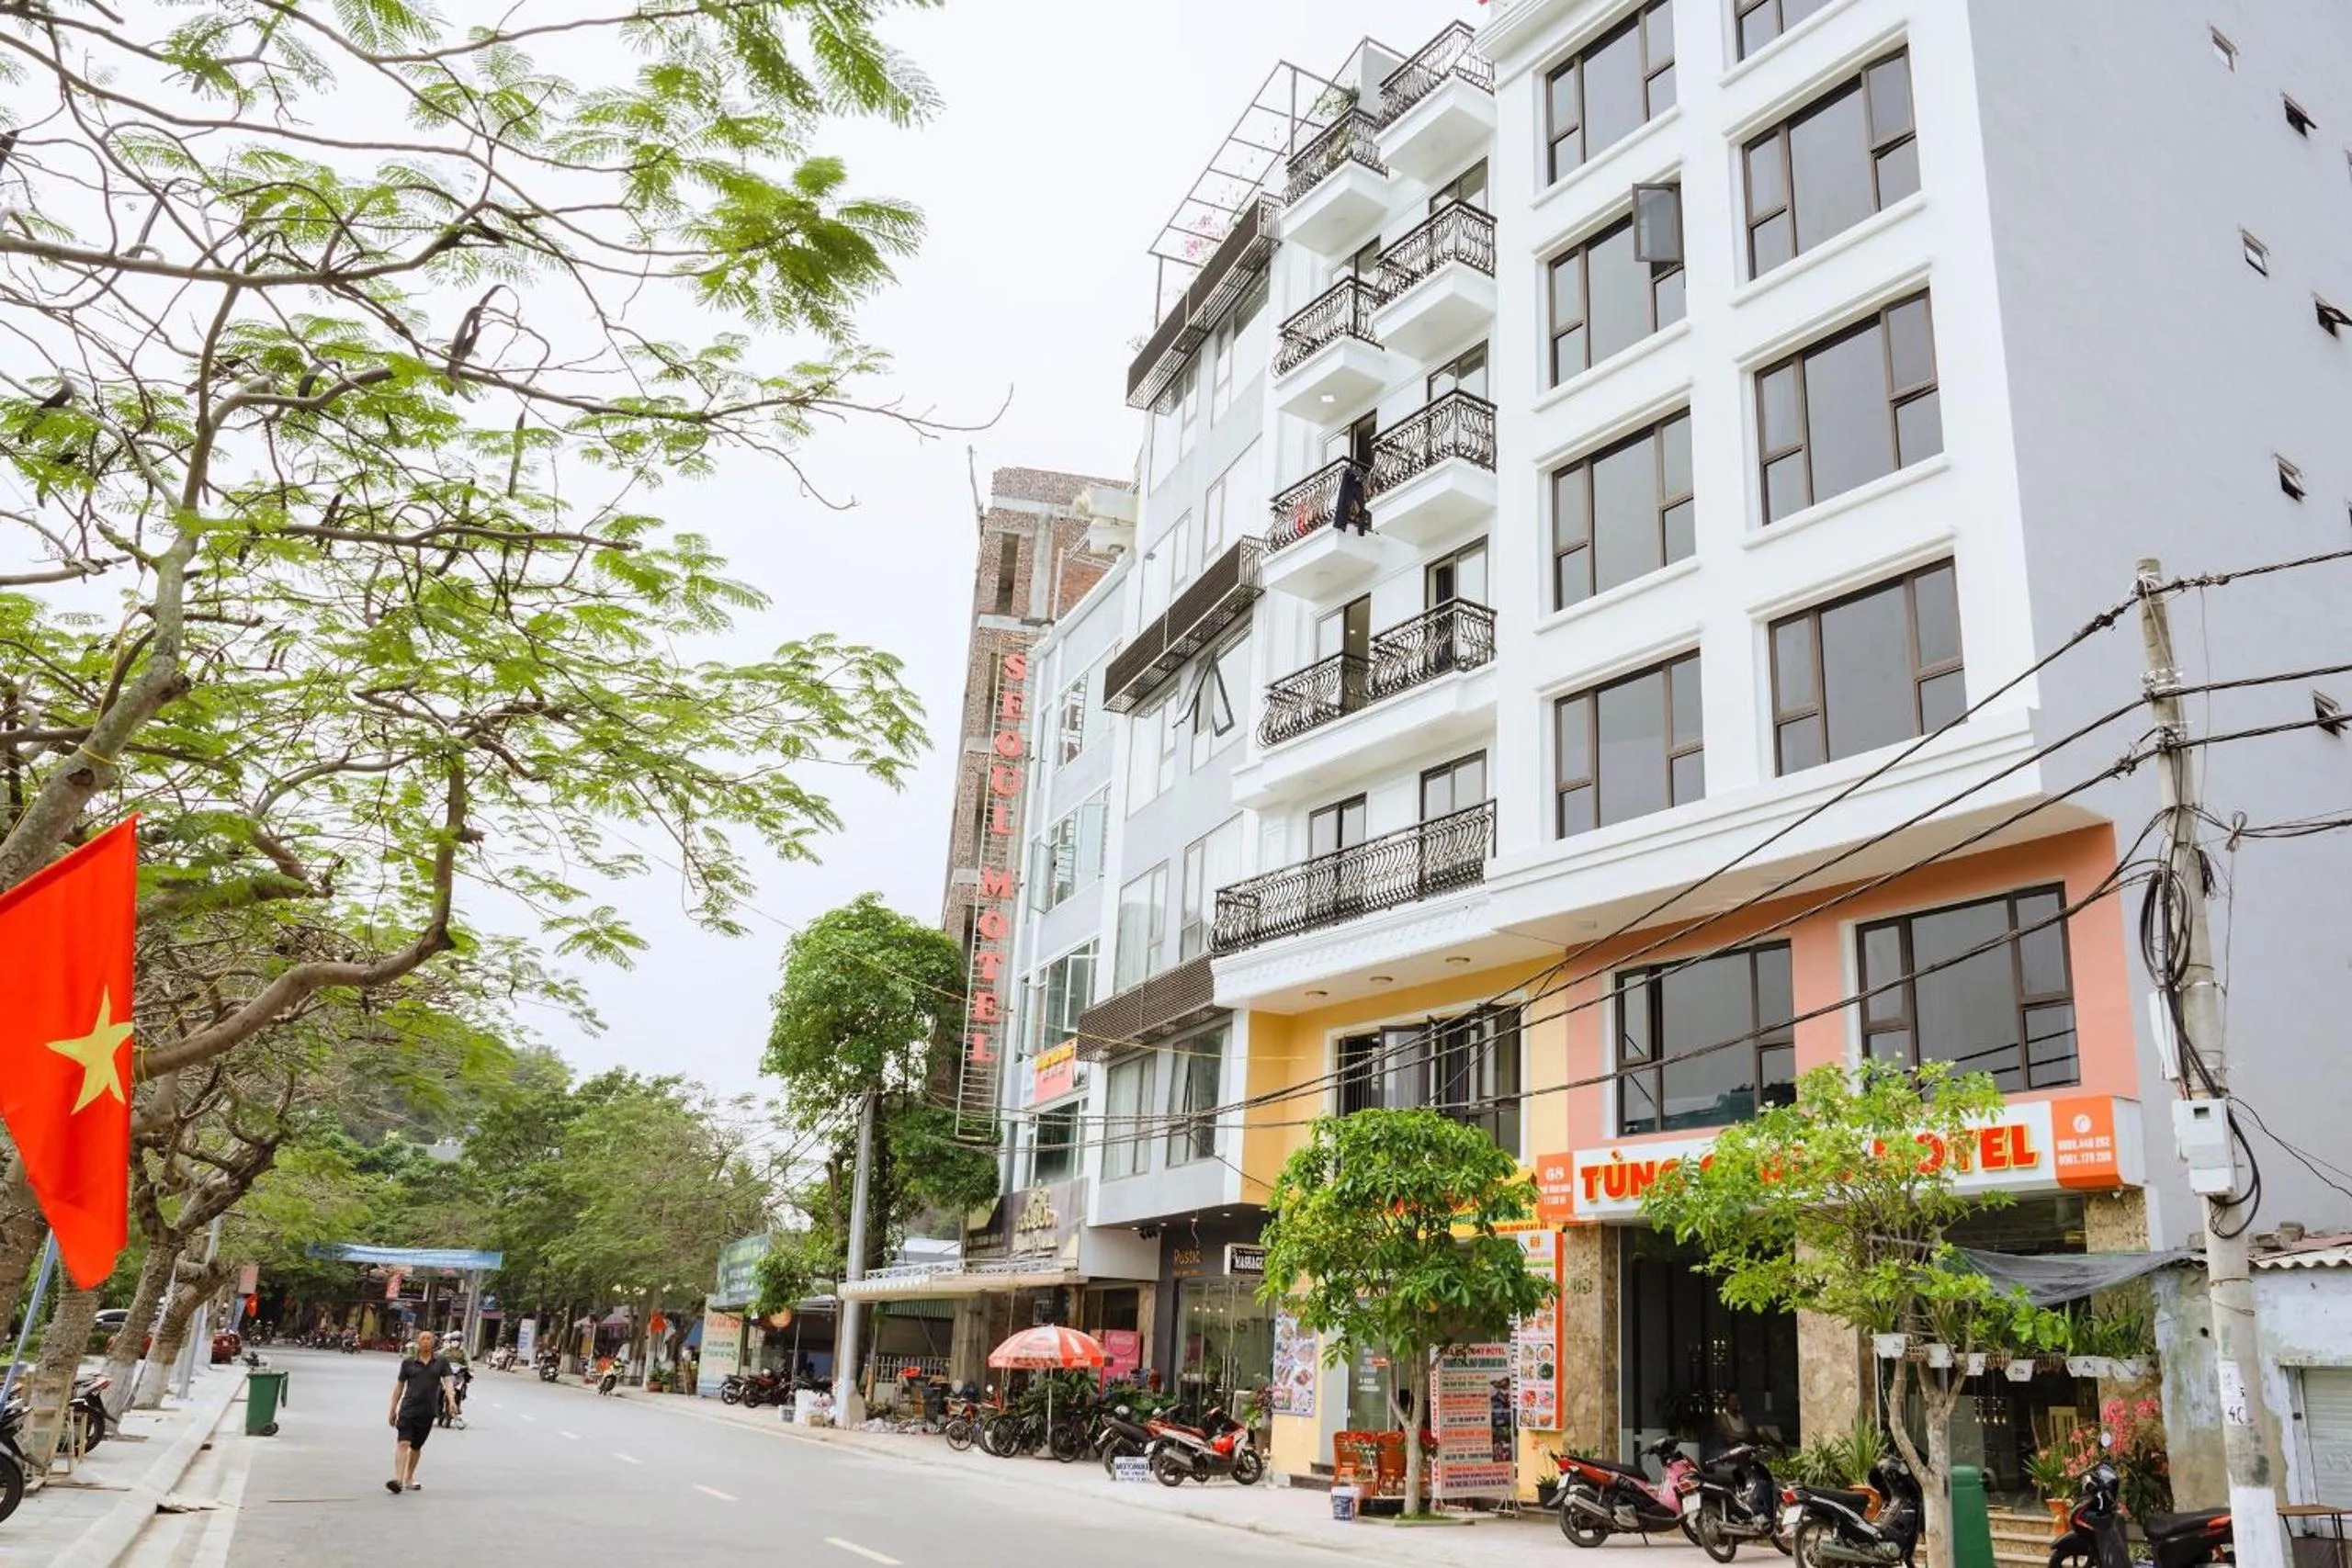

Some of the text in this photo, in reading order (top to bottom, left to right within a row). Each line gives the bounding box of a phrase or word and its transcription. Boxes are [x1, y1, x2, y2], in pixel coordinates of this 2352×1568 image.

[967, 653, 1026, 1063] SEOUL MOTEL
[1871, 1123, 2041, 1177] OTEL
